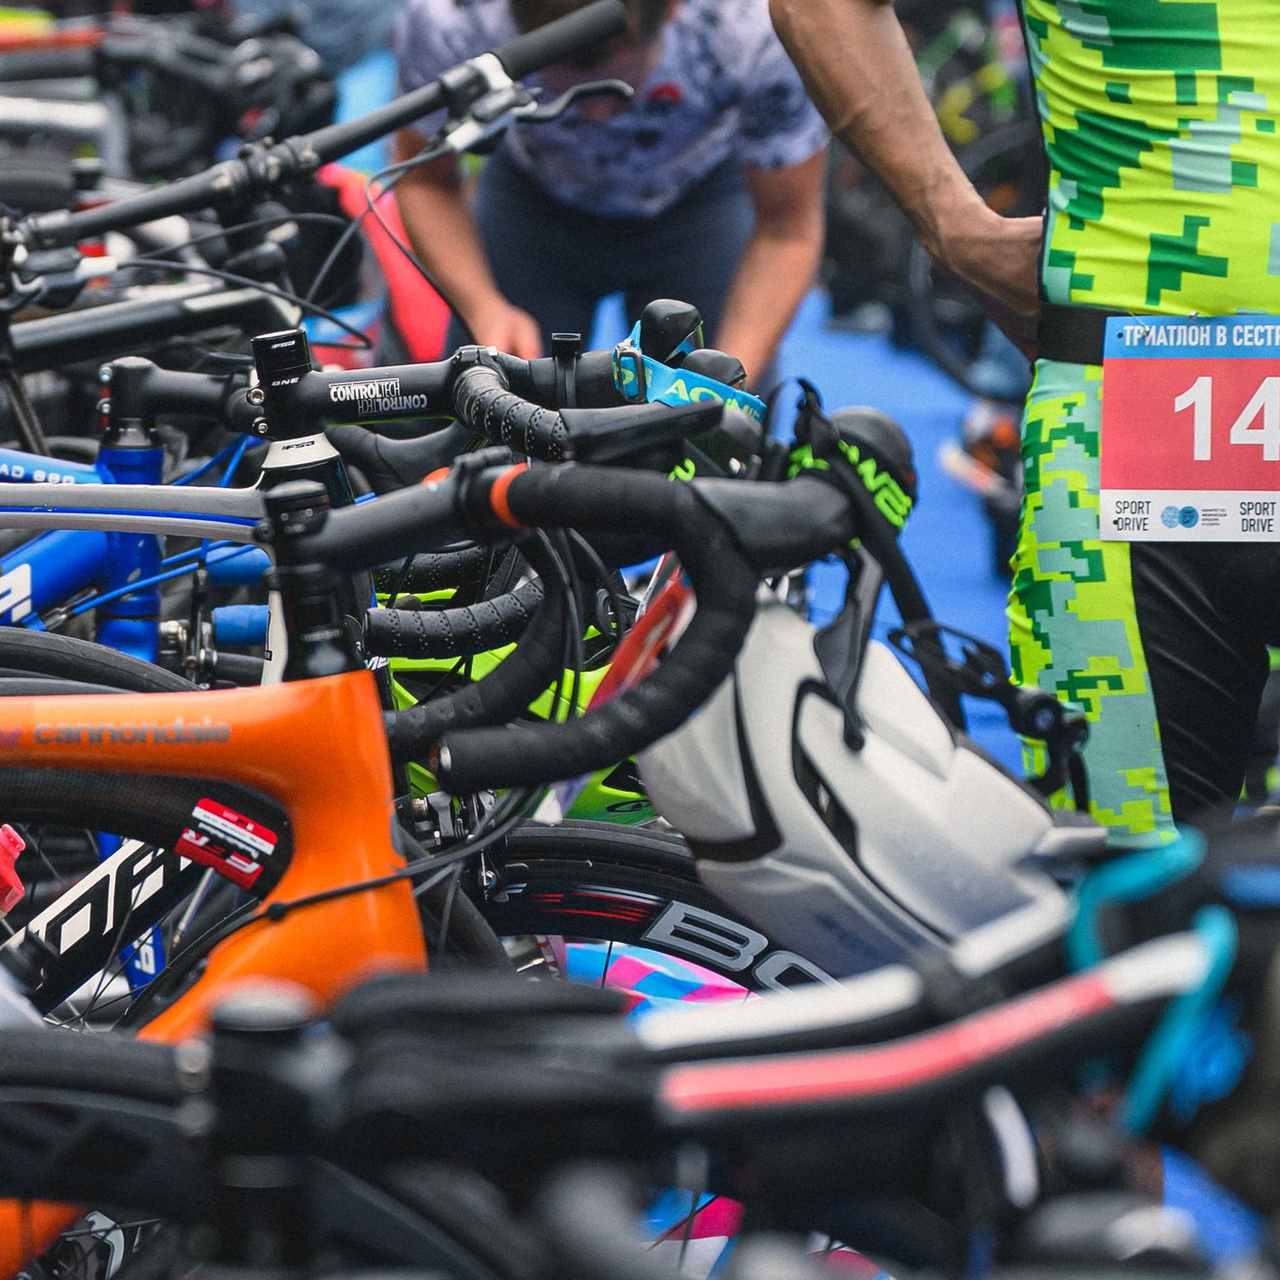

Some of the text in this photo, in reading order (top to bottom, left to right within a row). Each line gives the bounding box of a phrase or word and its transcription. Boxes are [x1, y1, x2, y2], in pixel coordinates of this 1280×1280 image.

[1123, 324, 1210, 347] ТРИАТЛОН
[1215, 326, 1228, 347] В
[1115, 500, 1152, 515] SPORT
[1240, 501, 1277, 516] SPORT
[1117, 517, 1149, 532] DRIVE
[1241, 518, 1274, 532] DRIVE
[33, 716, 232, 745] cannondale
